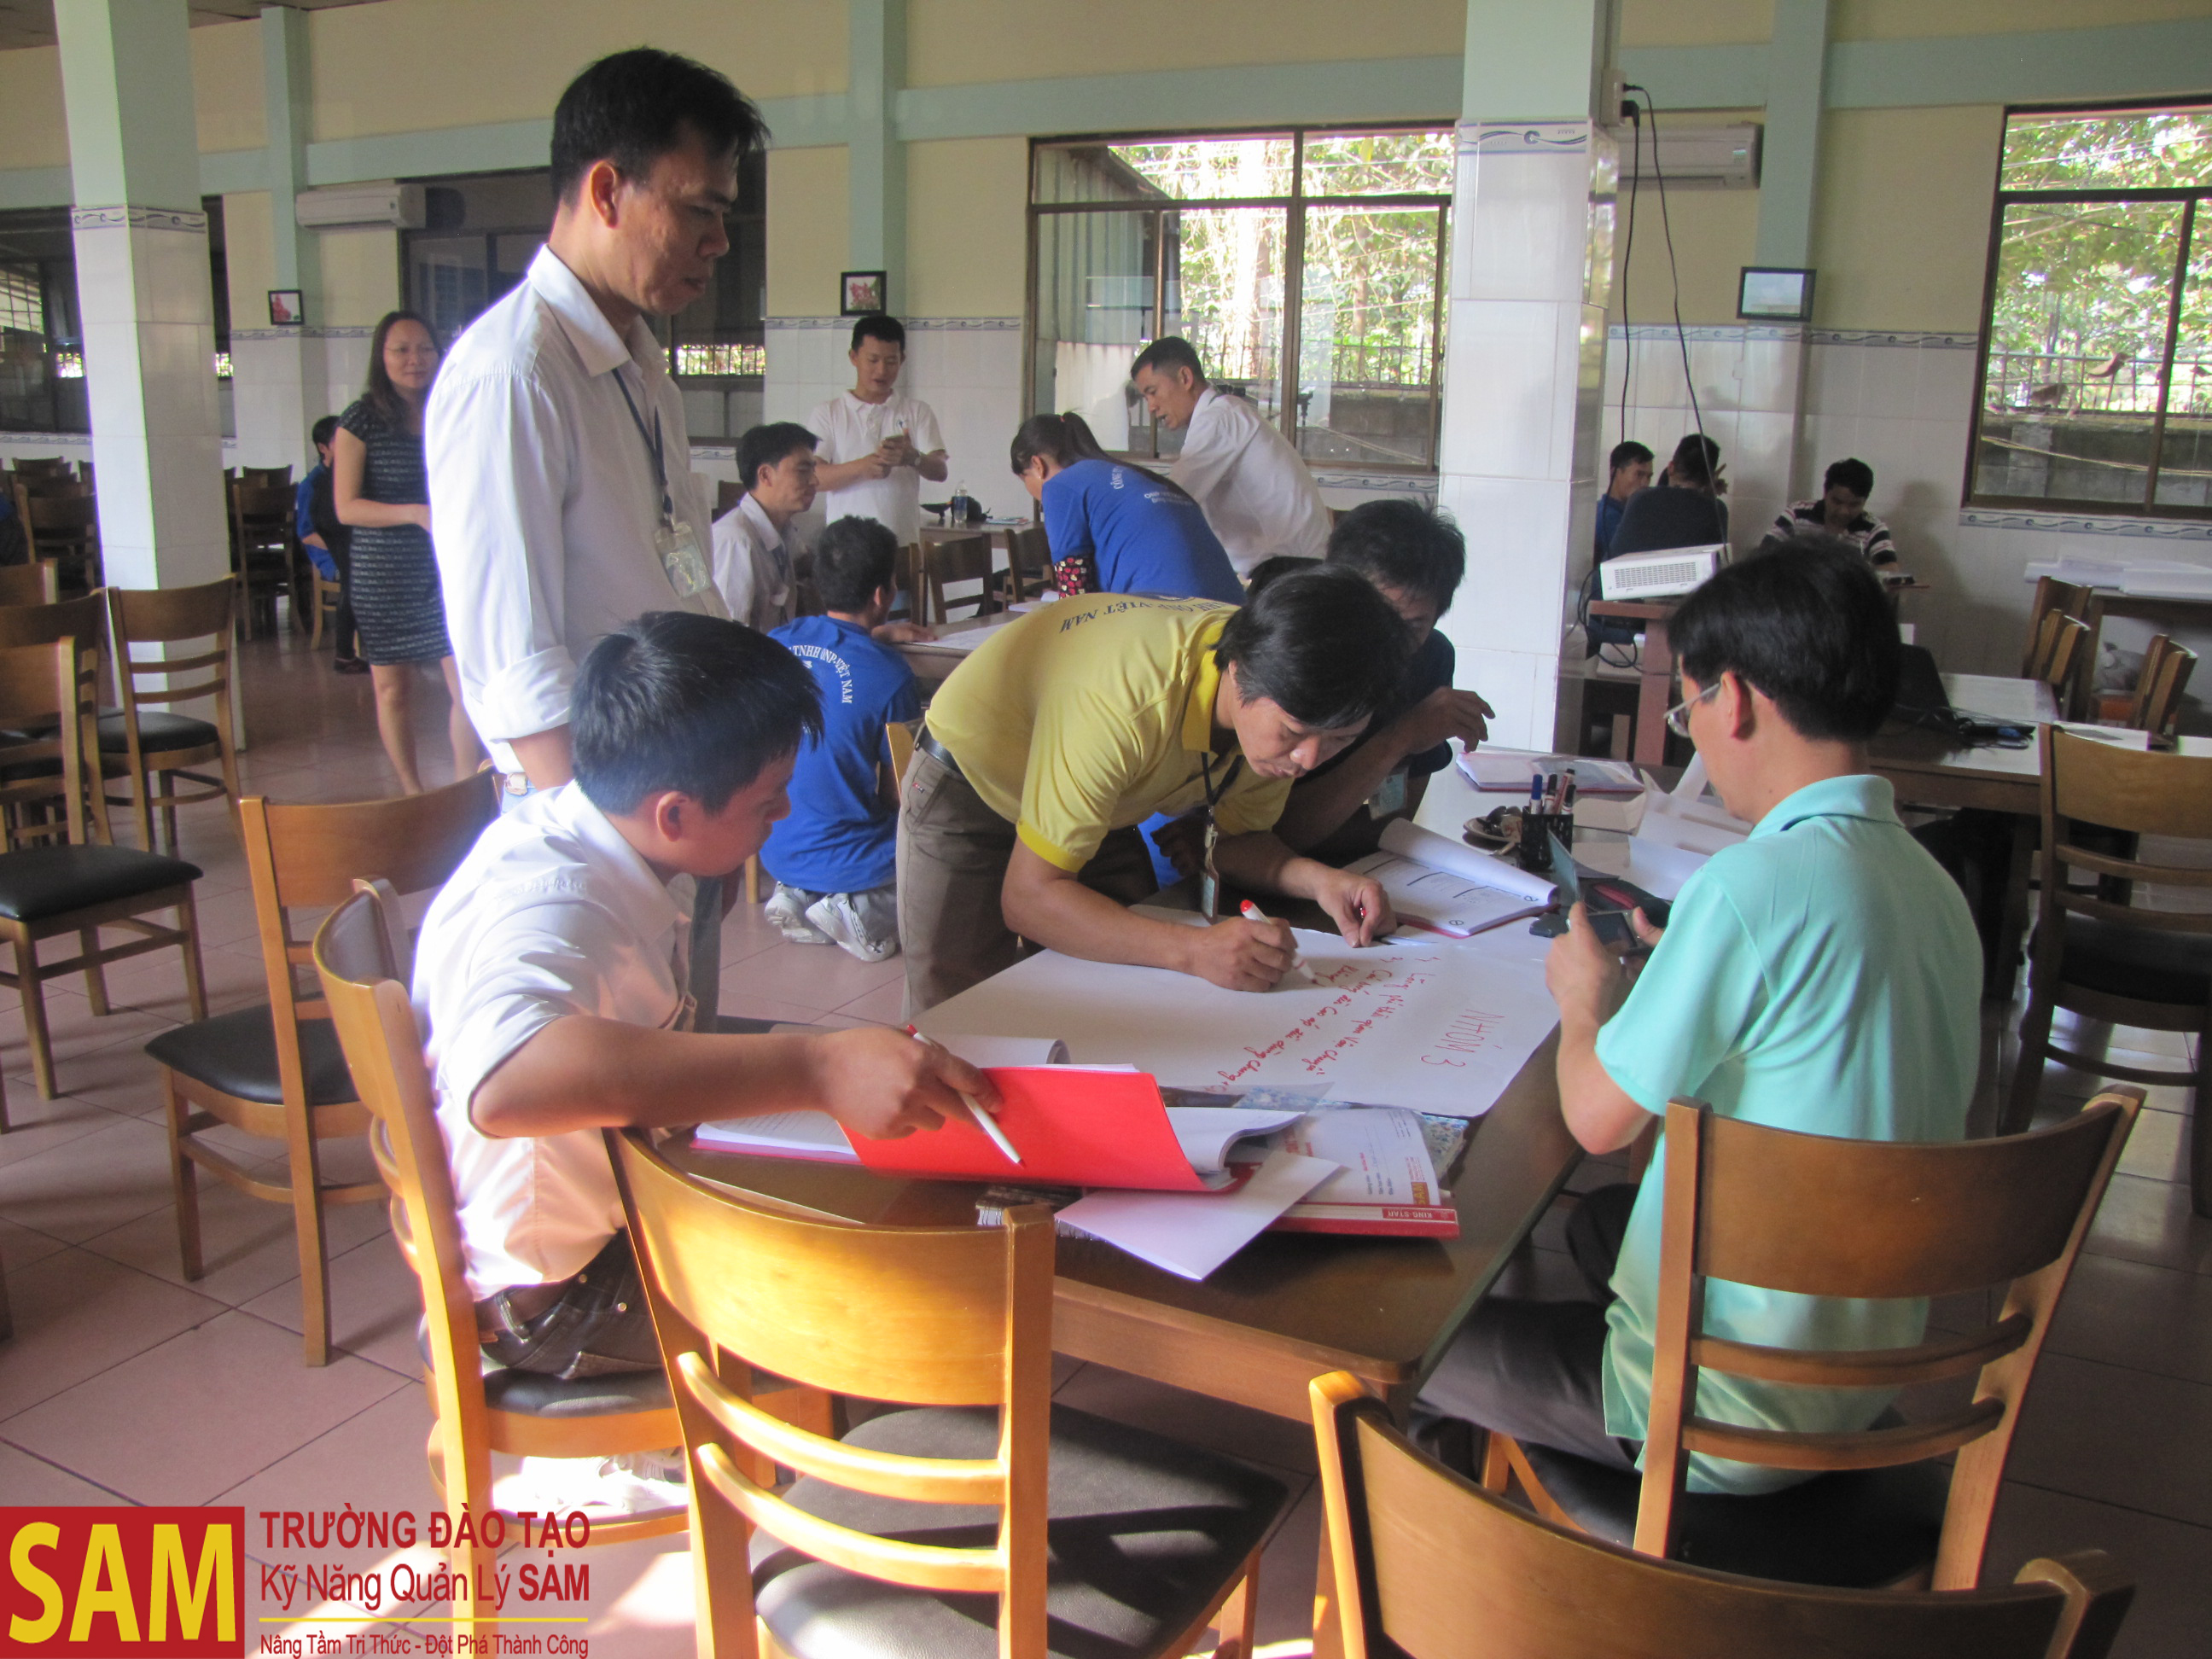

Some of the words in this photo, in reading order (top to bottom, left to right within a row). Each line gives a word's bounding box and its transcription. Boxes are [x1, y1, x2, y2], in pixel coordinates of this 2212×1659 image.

[1059, 608, 1099, 633] NAM
[792, 644, 822, 659] TNHH
[841, 679, 853, 704] NAM
[1420, 1054, 1466, 1068] 3
[1388, 1210, 1434, 1219] KING-STAR
